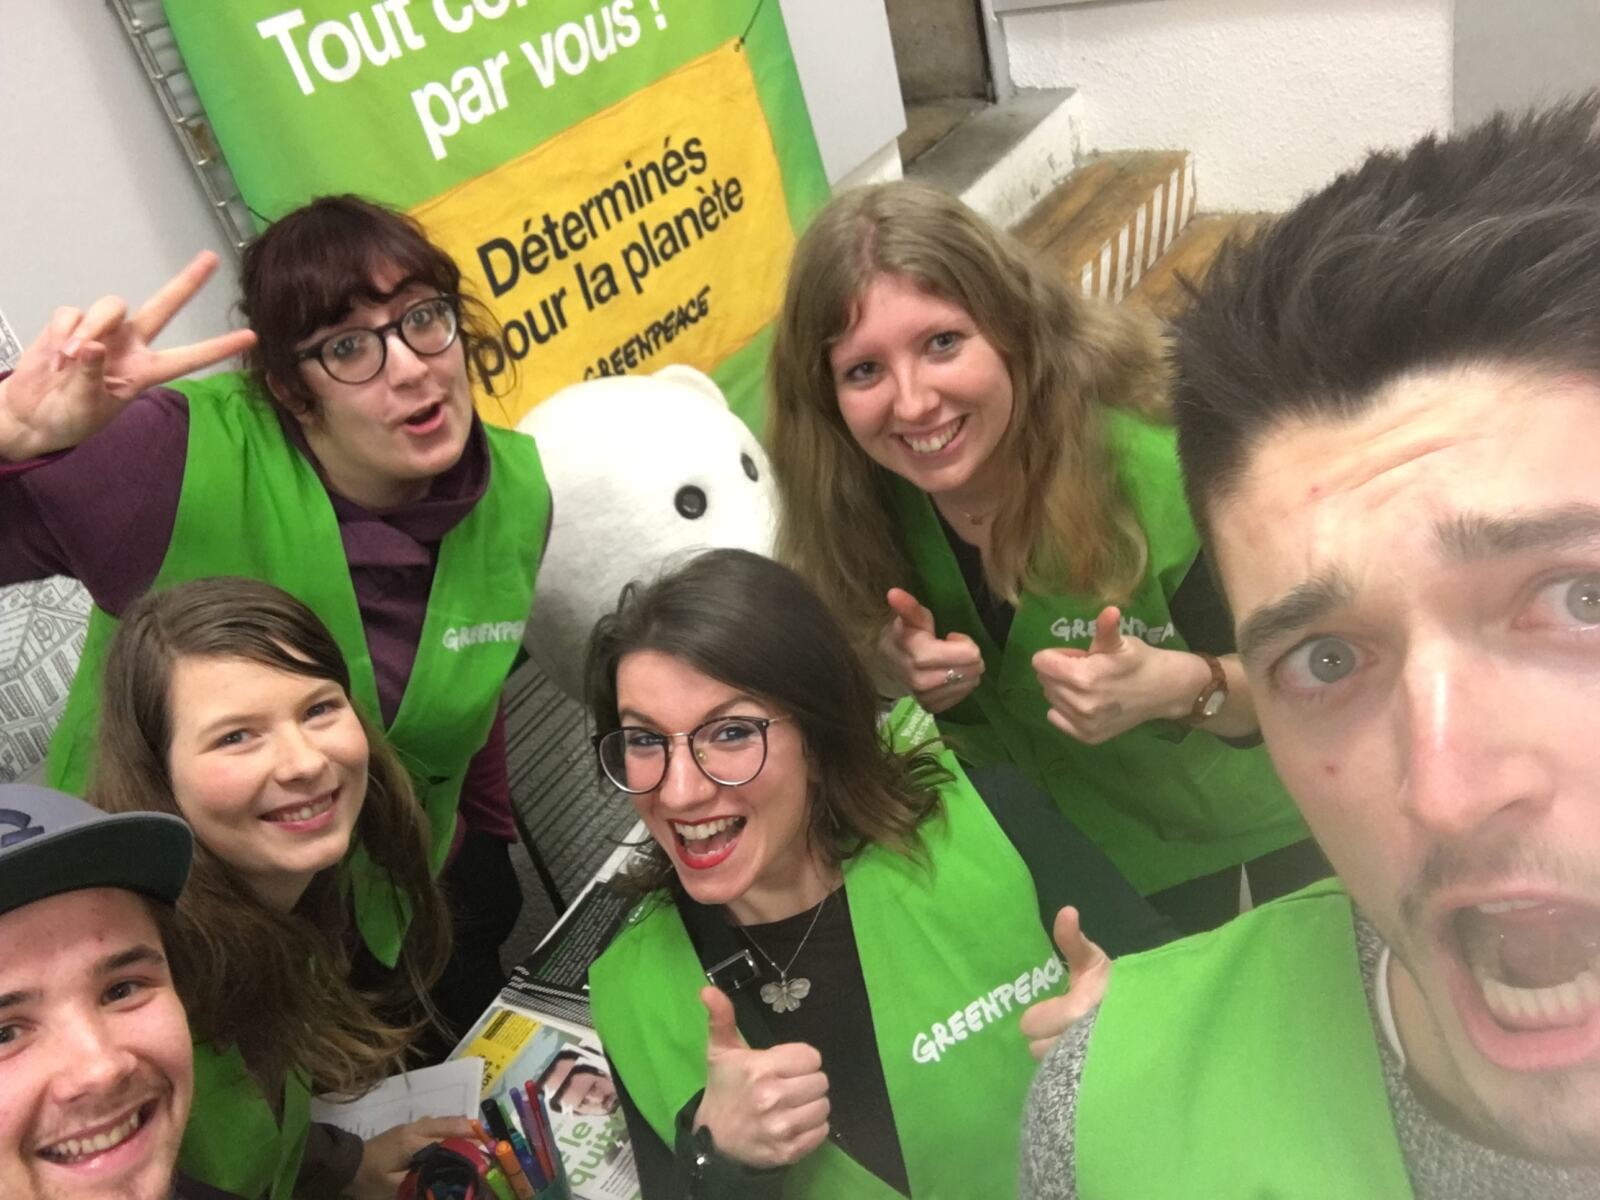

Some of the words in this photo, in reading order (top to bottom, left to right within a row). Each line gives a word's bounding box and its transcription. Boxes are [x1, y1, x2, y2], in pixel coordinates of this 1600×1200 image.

[256, 0, 426, 95] Tout
[410, 50, 510, 162] par
[520, 0, 641, 88] vous
[473, 287, 567, 396] pour
[573, 262, 620, 312] la
[621, 177, 744, 295] planète
[476, 136, 707, 299] Déterminés
[1050, 616, 1176, 644] GRENPEA
